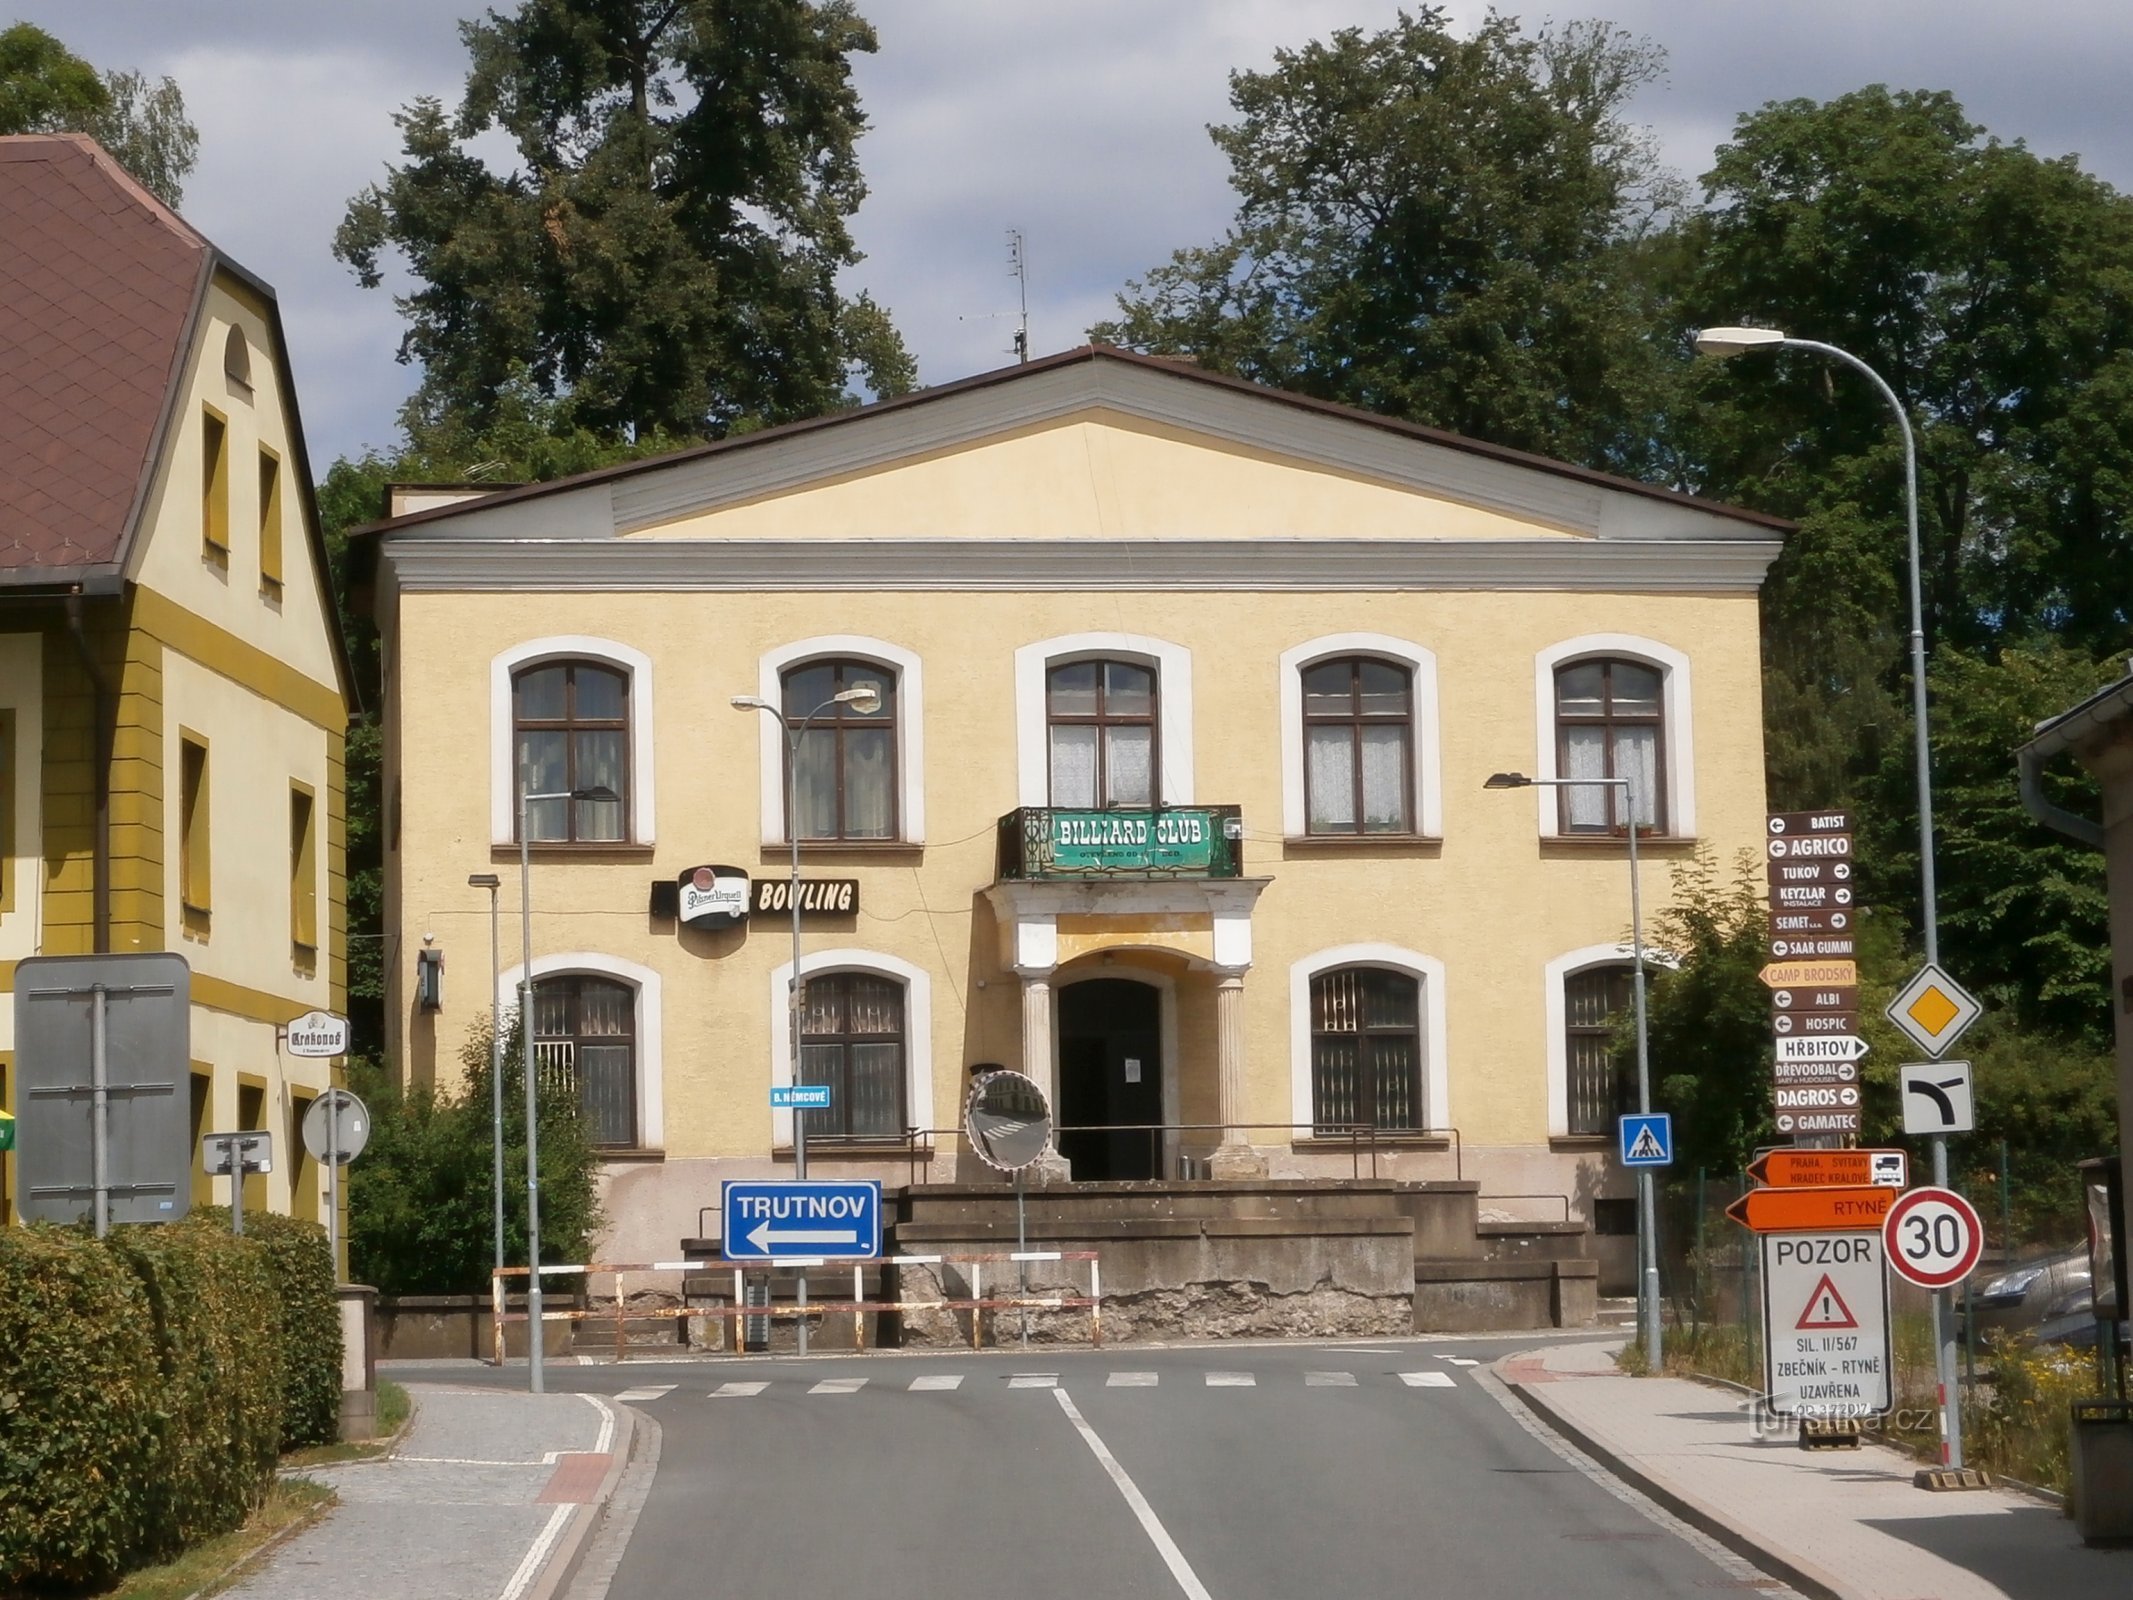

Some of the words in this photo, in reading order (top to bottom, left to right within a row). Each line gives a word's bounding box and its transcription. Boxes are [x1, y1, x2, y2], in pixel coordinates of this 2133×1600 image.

[1811, 815, 1845, 829] BATIST
[1059, 819, 1147, 846] BILLIARD
[1157, 818, 1202, 844] CLUB
[1791, 837, 1848, 856] AGRICO
[758, 883, 852, 911] BOWLING
[1780, 887, 1826, 900] KEYZLAR
[1776, 916, 1809, 930] SEMET
[1790, 942, 1815, 955] SAAR
[1817, 941, 1852, 954] GUMMI
[1770, 968, 1800, 982] CAMP
[1804, 967, 1852, 982] BRODSKY
[1815, 993, 1840, 1005] ALBI
[1806, 1018, 1847, 1031] HOSPIC
[1786, 1039, 1849, 1057] HŘBITOV
[1776, 1062, 1838, 1077] DŘEVOOBAL
[774, 1093, 782, 1102] B.
[1777, 1090, 1837, 1107] DAGROS
[1798, 1115, 1856, 1130] GAMATEC
[1790, 1173, 1825, 1184] HRADEC
[737, 1196, 866, 1219] TRUTNOV
[1834, 1199, 1888, 1216] RTYNĚ
[1904, 1214, 1960, 1260] 30
[1777, 1239, 1872, 1265] POZOR
[1796, 1339, 1819, 1353] SIL.
[1822, 1336, 1858, 1352] II/567
[1777, 1359, 1827, 1377] ZBEČNÍK
[1842, 1356, 1880, 1375] RTYNĚ
[1800, 1382, 1860, 1400] UZAVŘENA
